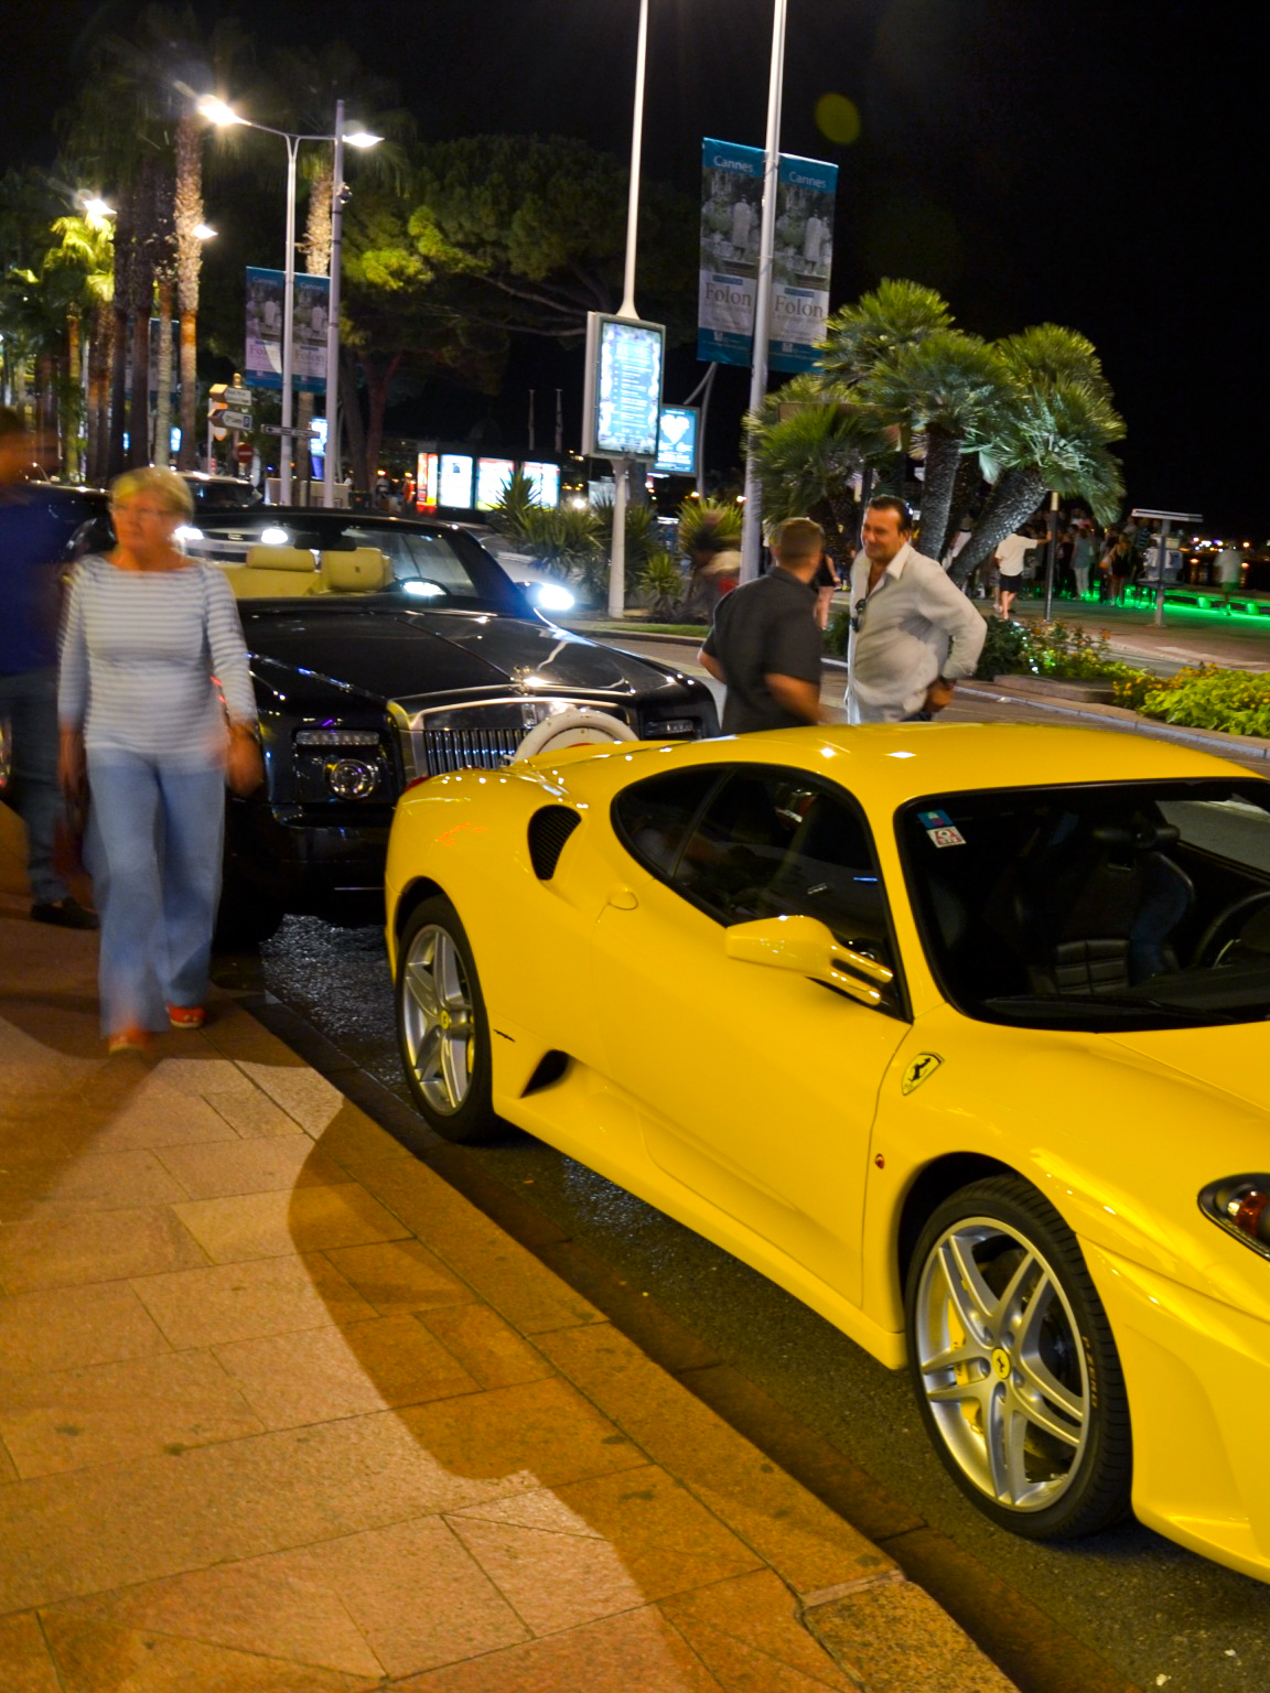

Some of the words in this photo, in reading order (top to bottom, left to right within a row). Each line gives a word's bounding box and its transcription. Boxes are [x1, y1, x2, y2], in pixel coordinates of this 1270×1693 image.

[713, 155, 754, 172] Cannes
[789, 171, 827, 188] Cannes
[705, 282, 752, 307] Folon
[774, 296, 824, 318] Folon
